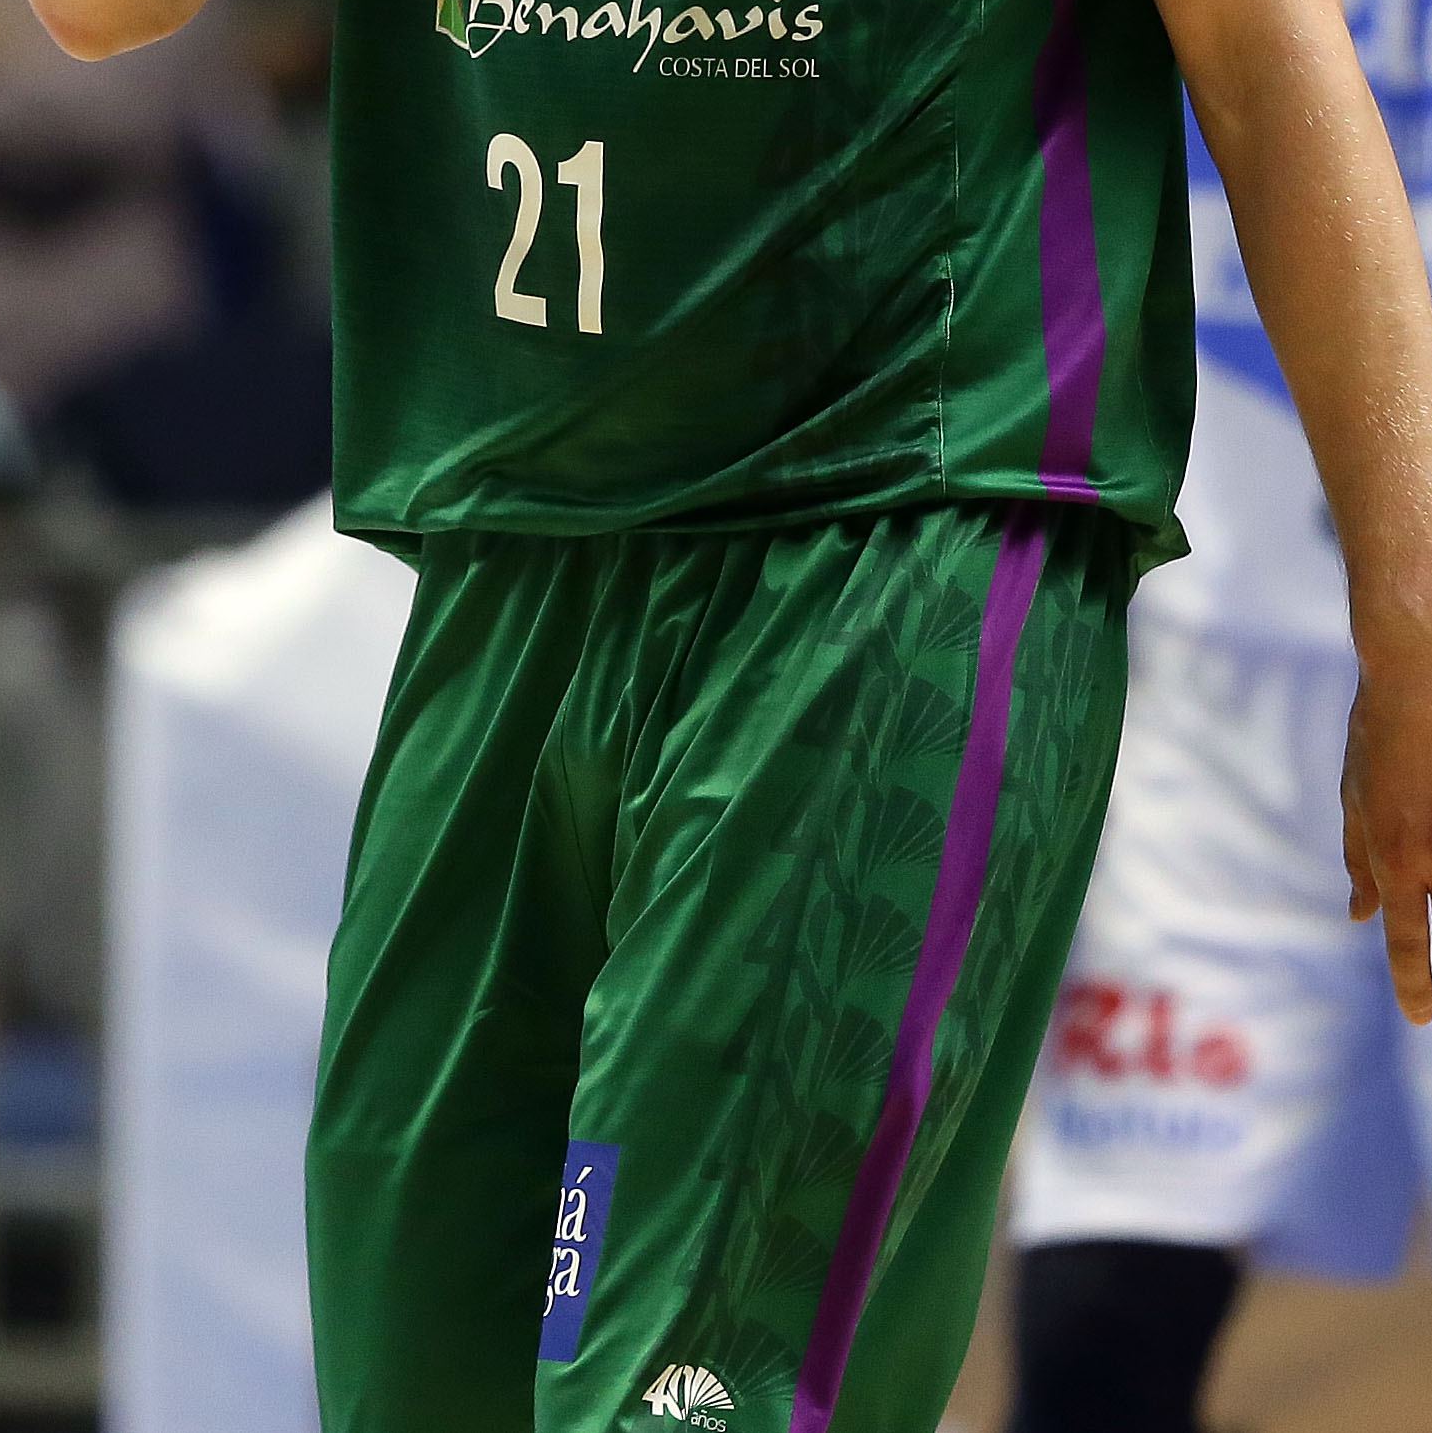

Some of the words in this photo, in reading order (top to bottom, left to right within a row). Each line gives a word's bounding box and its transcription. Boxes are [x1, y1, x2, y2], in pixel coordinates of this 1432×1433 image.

[658, 56, 729, 79] COSTA
[734, 57, 773, 78] DEL
[778, 57, 820, 79] SOL
[486, 132, 605, 335] 21
[690, 1409, 727, 1433] años
